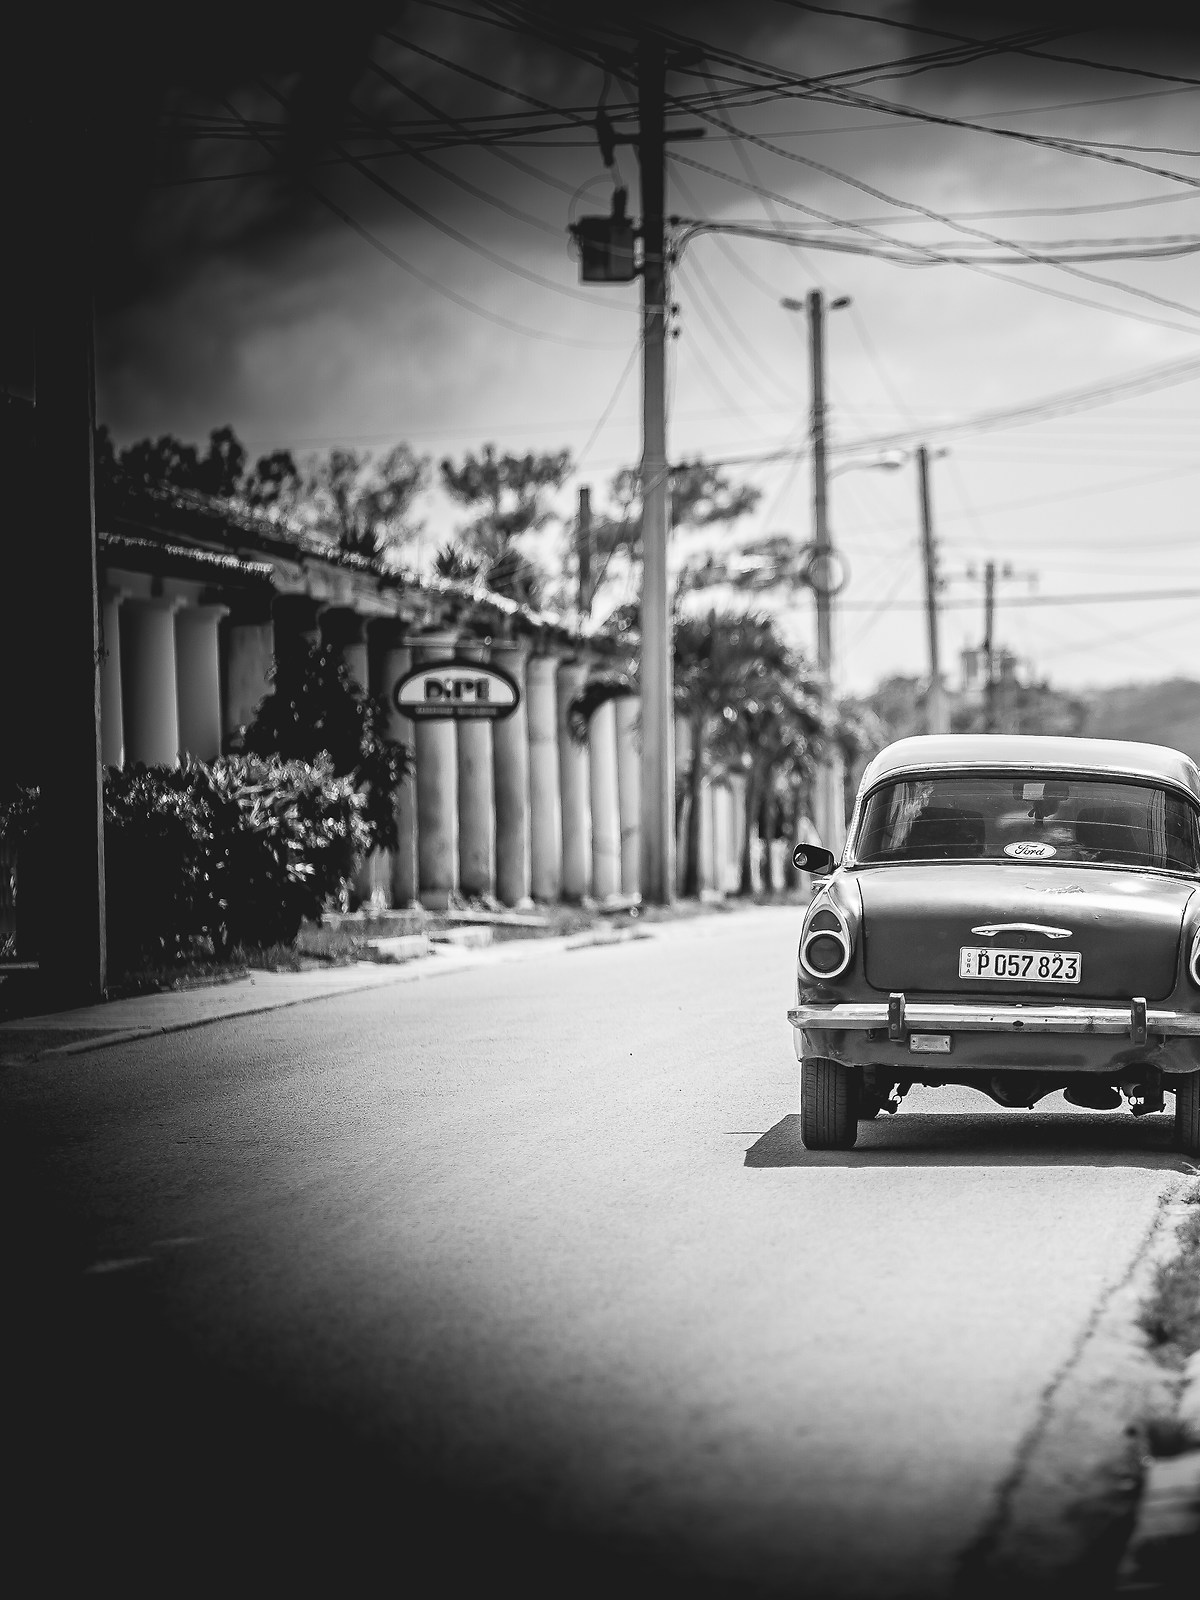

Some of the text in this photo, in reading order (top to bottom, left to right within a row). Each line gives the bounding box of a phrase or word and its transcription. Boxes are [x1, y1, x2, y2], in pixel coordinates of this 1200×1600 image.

[1014, 844, 1046, 856] Ford
[977, 953, 1078, 980] P 057 823
